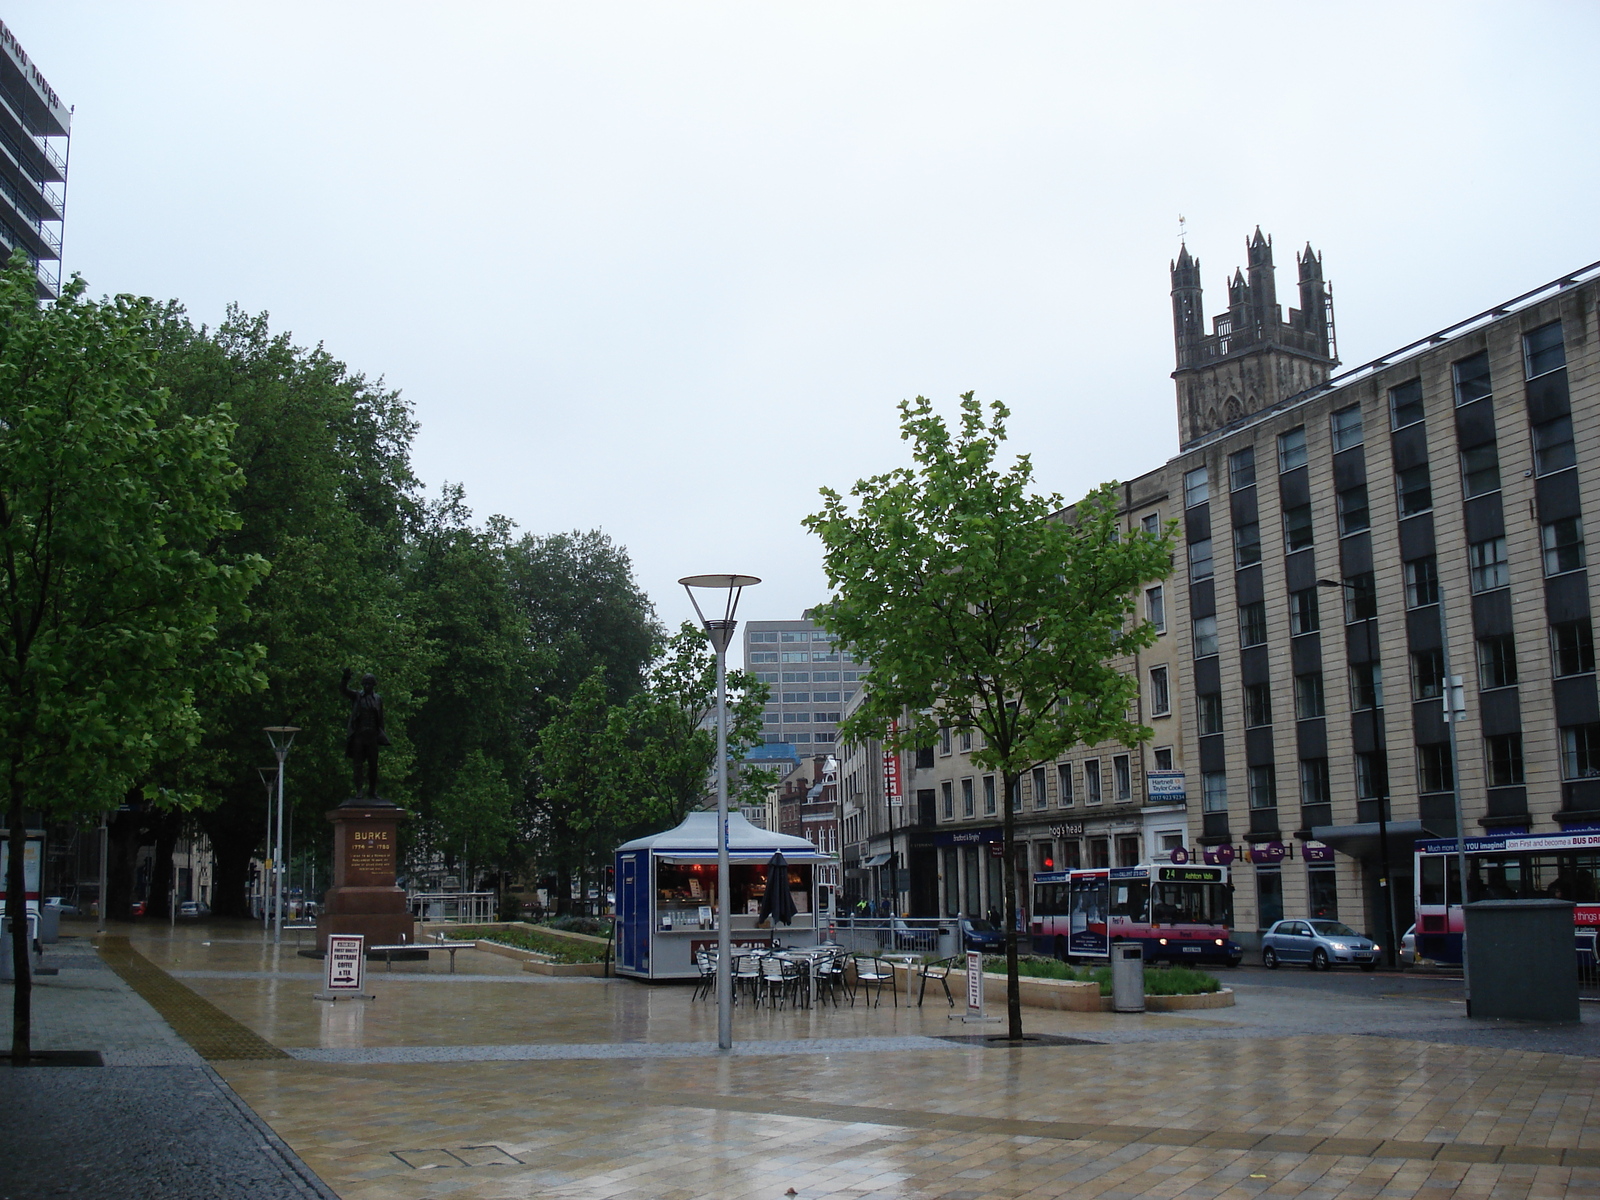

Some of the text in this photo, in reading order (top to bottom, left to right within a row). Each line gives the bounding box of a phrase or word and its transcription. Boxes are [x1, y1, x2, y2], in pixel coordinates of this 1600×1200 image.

[31, 63, 60, 110] TOWER
[883, 760, 896, 776] TO
[884, 776, 897, 795] LET
[354, 831, 388, 840] BURKE
[1048, 822, 1083, 838] hog's head
[1427, 844, 1441, 852] Much
[1466, 842, 1479, 850] YOU
[1480, 840, 1506, 851] imagine!
[1545, 839, 1566, 847] become
[1166, 869, 1214, 880] 24 Ashton Vale
[1577, 912, 1597, 923] things
